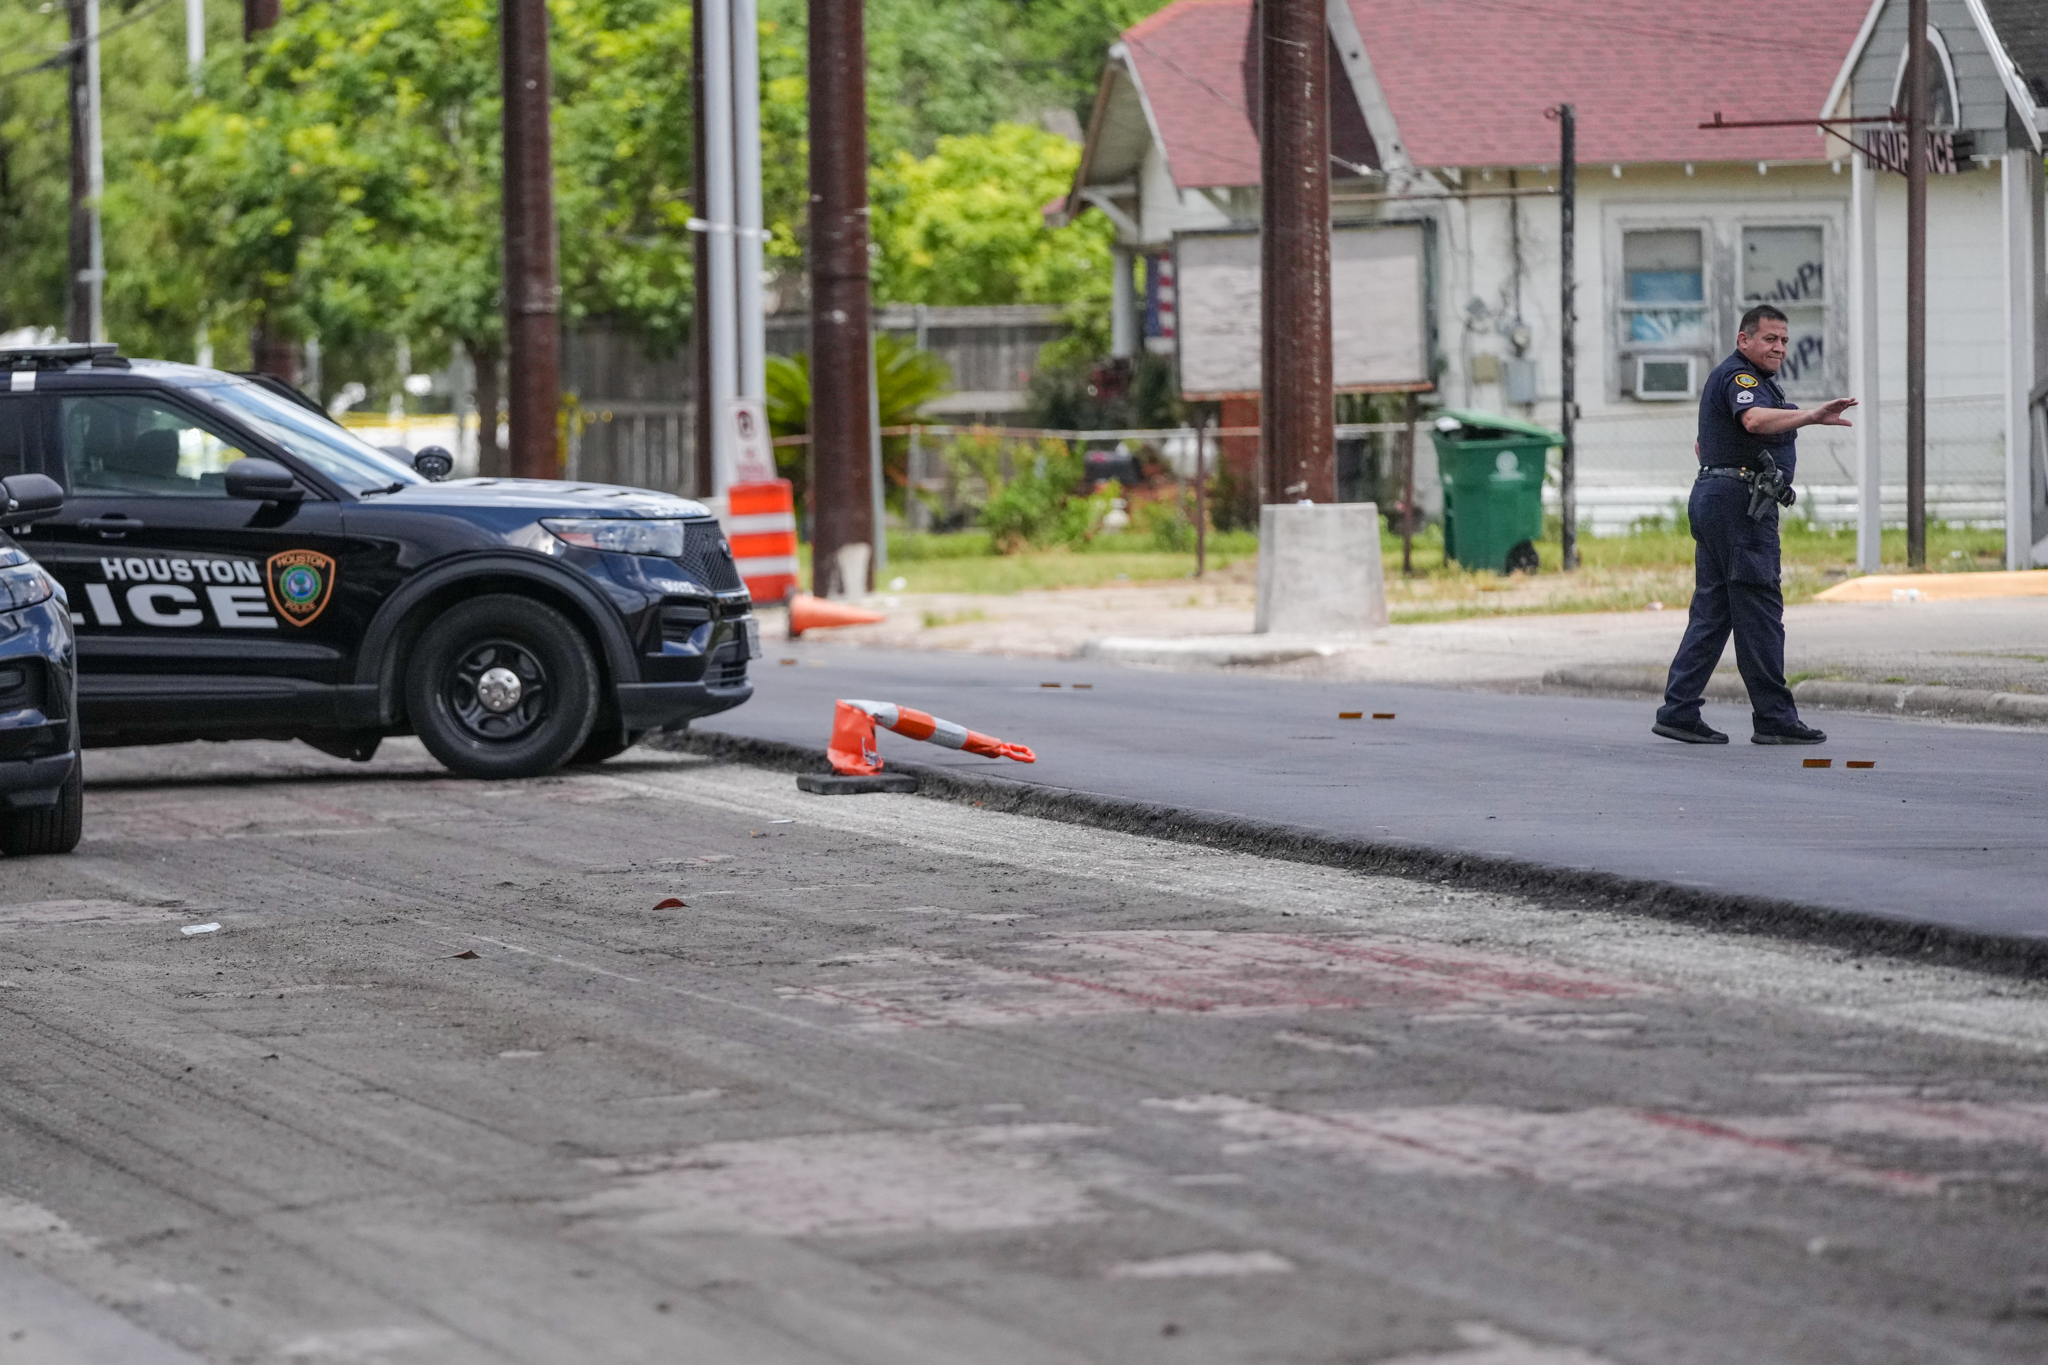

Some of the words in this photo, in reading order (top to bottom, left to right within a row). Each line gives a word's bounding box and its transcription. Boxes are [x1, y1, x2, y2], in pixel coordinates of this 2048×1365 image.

[1863, 129, 1958, 174] INSURNCE
[100, 557, 262, 584] HOUSTON
[276, 553, 327, 569] HOUSTON
[70, 583, 279, 628] ICE
